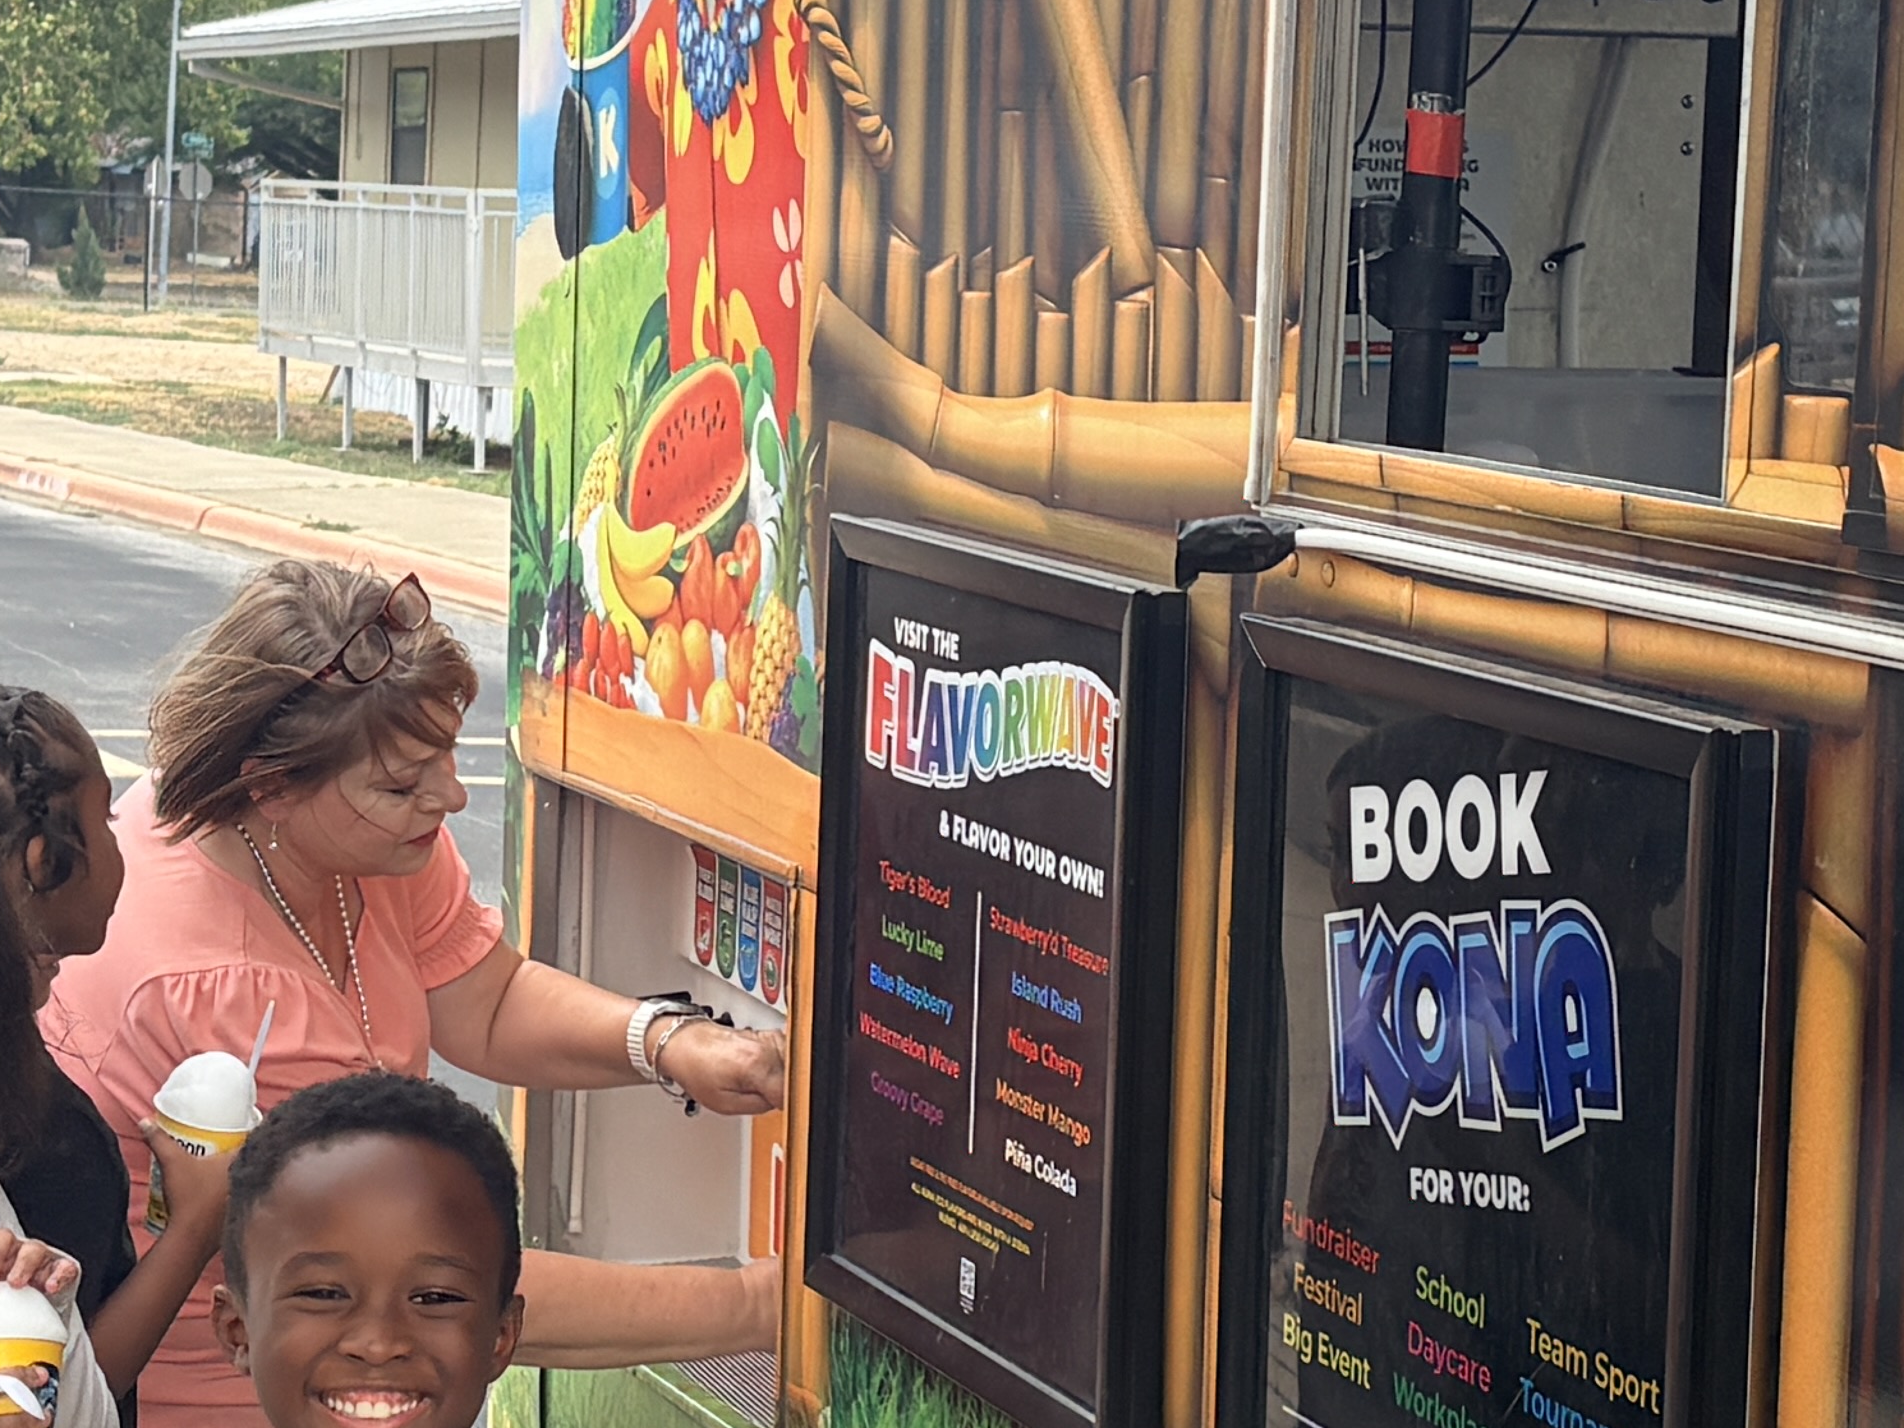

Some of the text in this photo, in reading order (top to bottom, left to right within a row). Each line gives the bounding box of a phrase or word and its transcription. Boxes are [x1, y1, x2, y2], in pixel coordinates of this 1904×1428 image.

[894, 617, 959, 660] VISIT THE
[939, 810, 1104, 898] & FLAVOR YOUR OWN!
[1350, 770, 1552, 883] BOOK
[879, 860, 951, 909] Tiger's Blood
[882, 914, 944, 961] Lucky Lime
[869, 962, 954, 1025] Blue Raspberry
[1011, 971, 1082, 1023] Island Rush
[859, 1011, 960, 1079] Watermelon Wave
[1007, 1026, 1083, 1087] Ninja Cherry
[1324, 899, 1623, 1153] KONA
[871, 1071, 944, 1126] Groovy Grape
[996, 1078, 1091, 1147] Monster Mango
[1004, 1138, 1032, 1173] Piña
[1034, 1154, 1077, 1197] Colada
[1409, 1167, 1531, 1212] FOR YOUR:
[1282, 1199, 1381, 1274] Fundraiser
[1293, 1262, 1363, 1326] Festival
[1415, 1265, 1486, 1329] School
[1283, 1313, 1371, 1390] Big Event
[1407, 1320, 1493, 1393] Daycare
[1526, 1317, 1661, 1415] Team Sport
